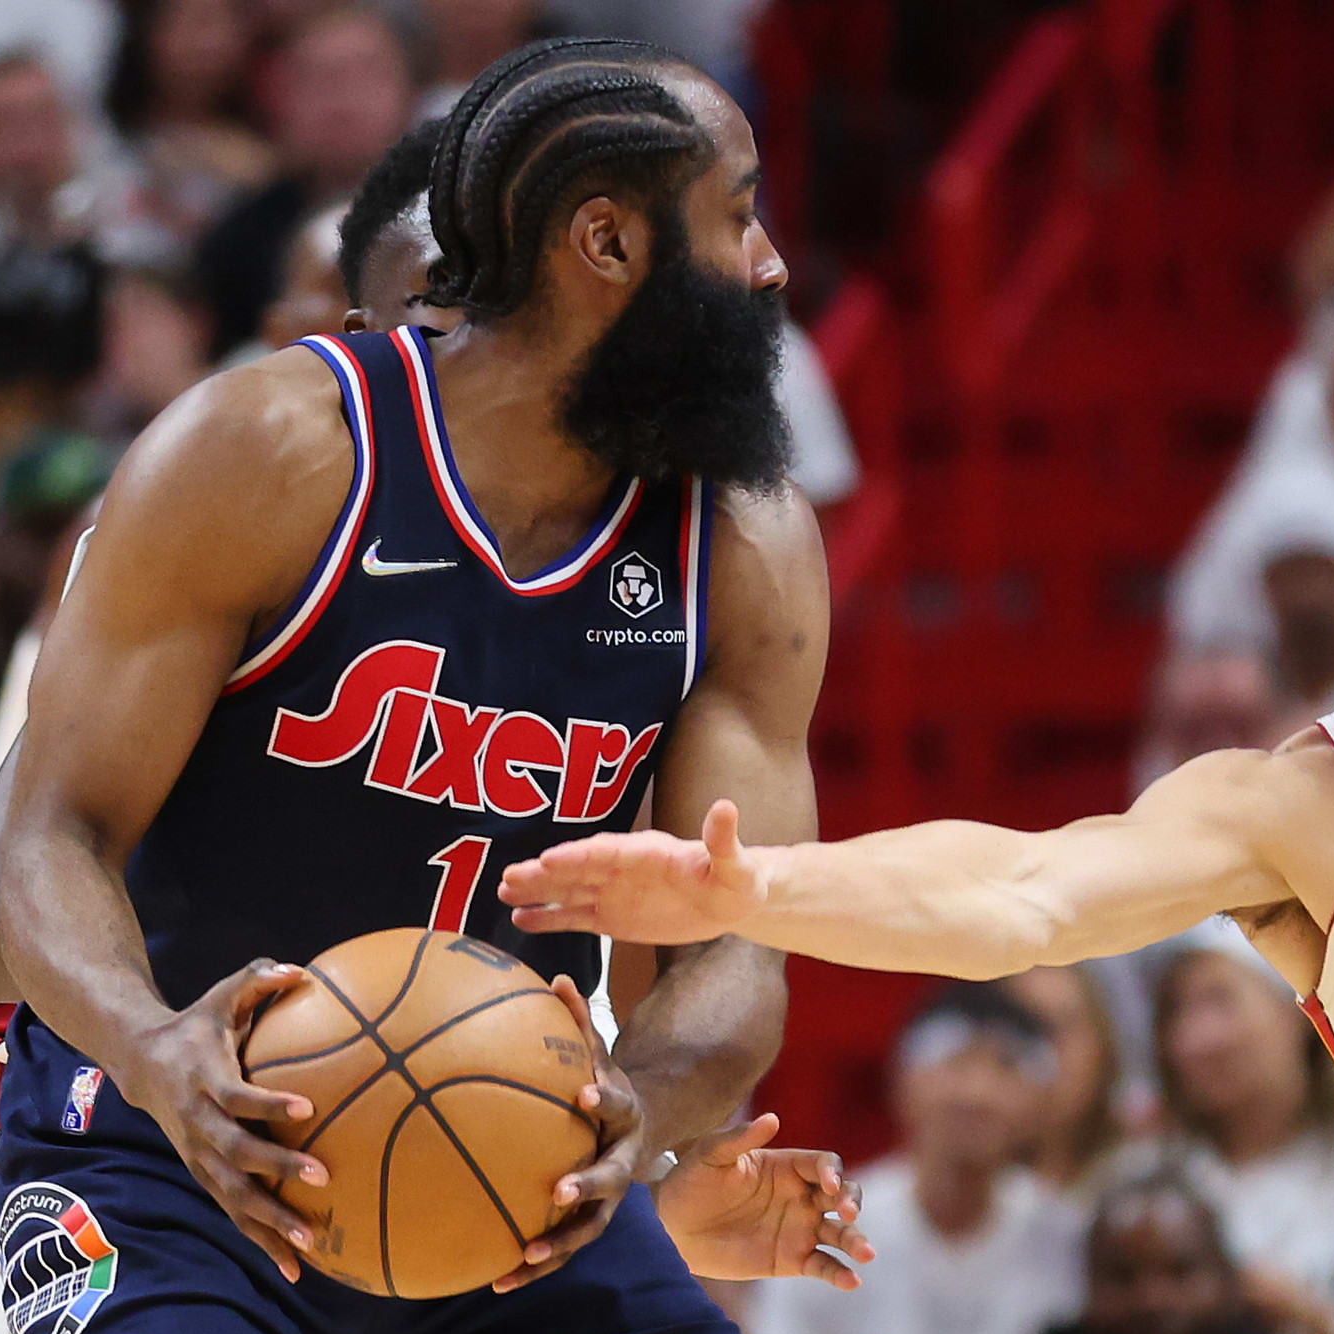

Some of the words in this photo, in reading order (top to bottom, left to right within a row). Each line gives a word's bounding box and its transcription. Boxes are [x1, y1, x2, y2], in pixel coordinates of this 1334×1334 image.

[586, 627, 685, 646] crypto.com
[267, 639, 664, 823] Sixers
[427, 834, 493, 936] 1
